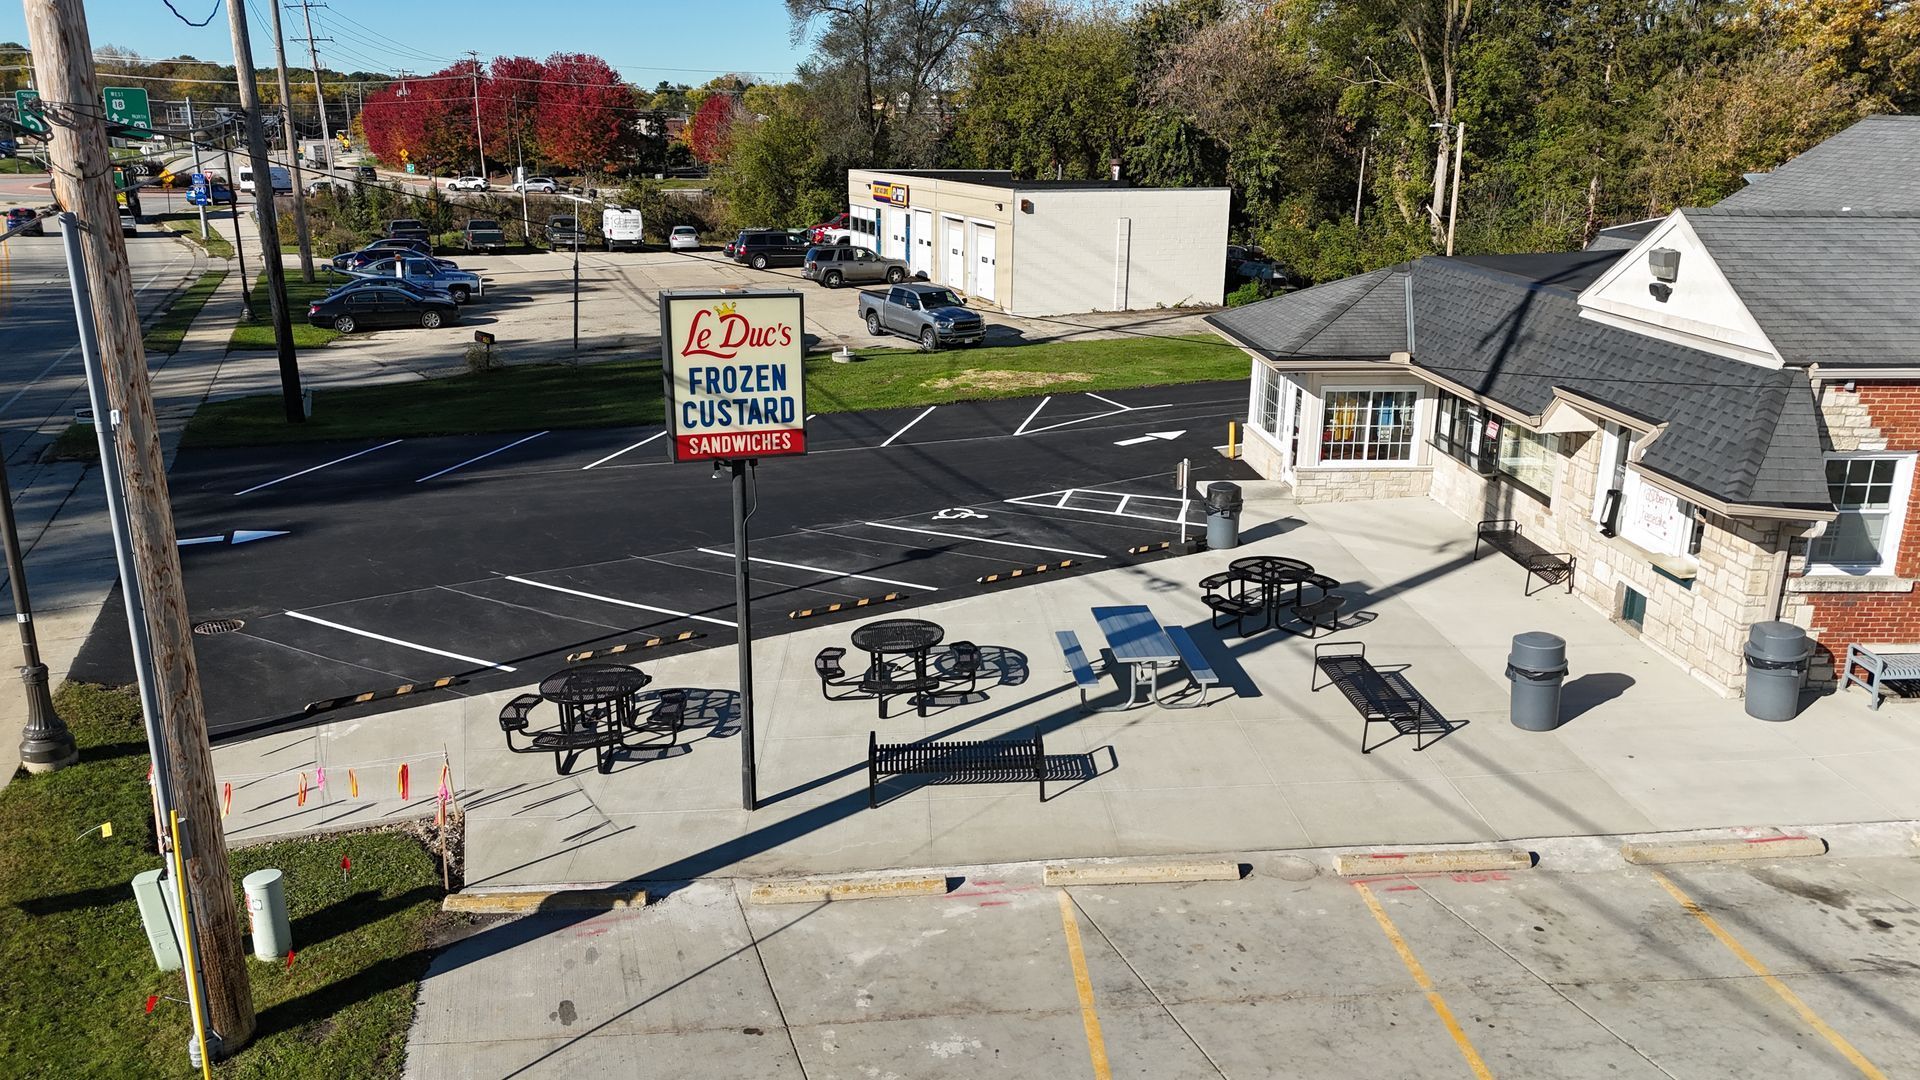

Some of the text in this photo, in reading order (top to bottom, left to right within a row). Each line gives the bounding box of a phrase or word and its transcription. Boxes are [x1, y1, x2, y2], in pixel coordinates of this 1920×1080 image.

[681, 309, 792, 359] Le Duc's
[689, 364, 787, 395] FROZEN
[682, 396, 795, 429] CUSTARD
[689, 432, 792, 455] SANDWICHES
